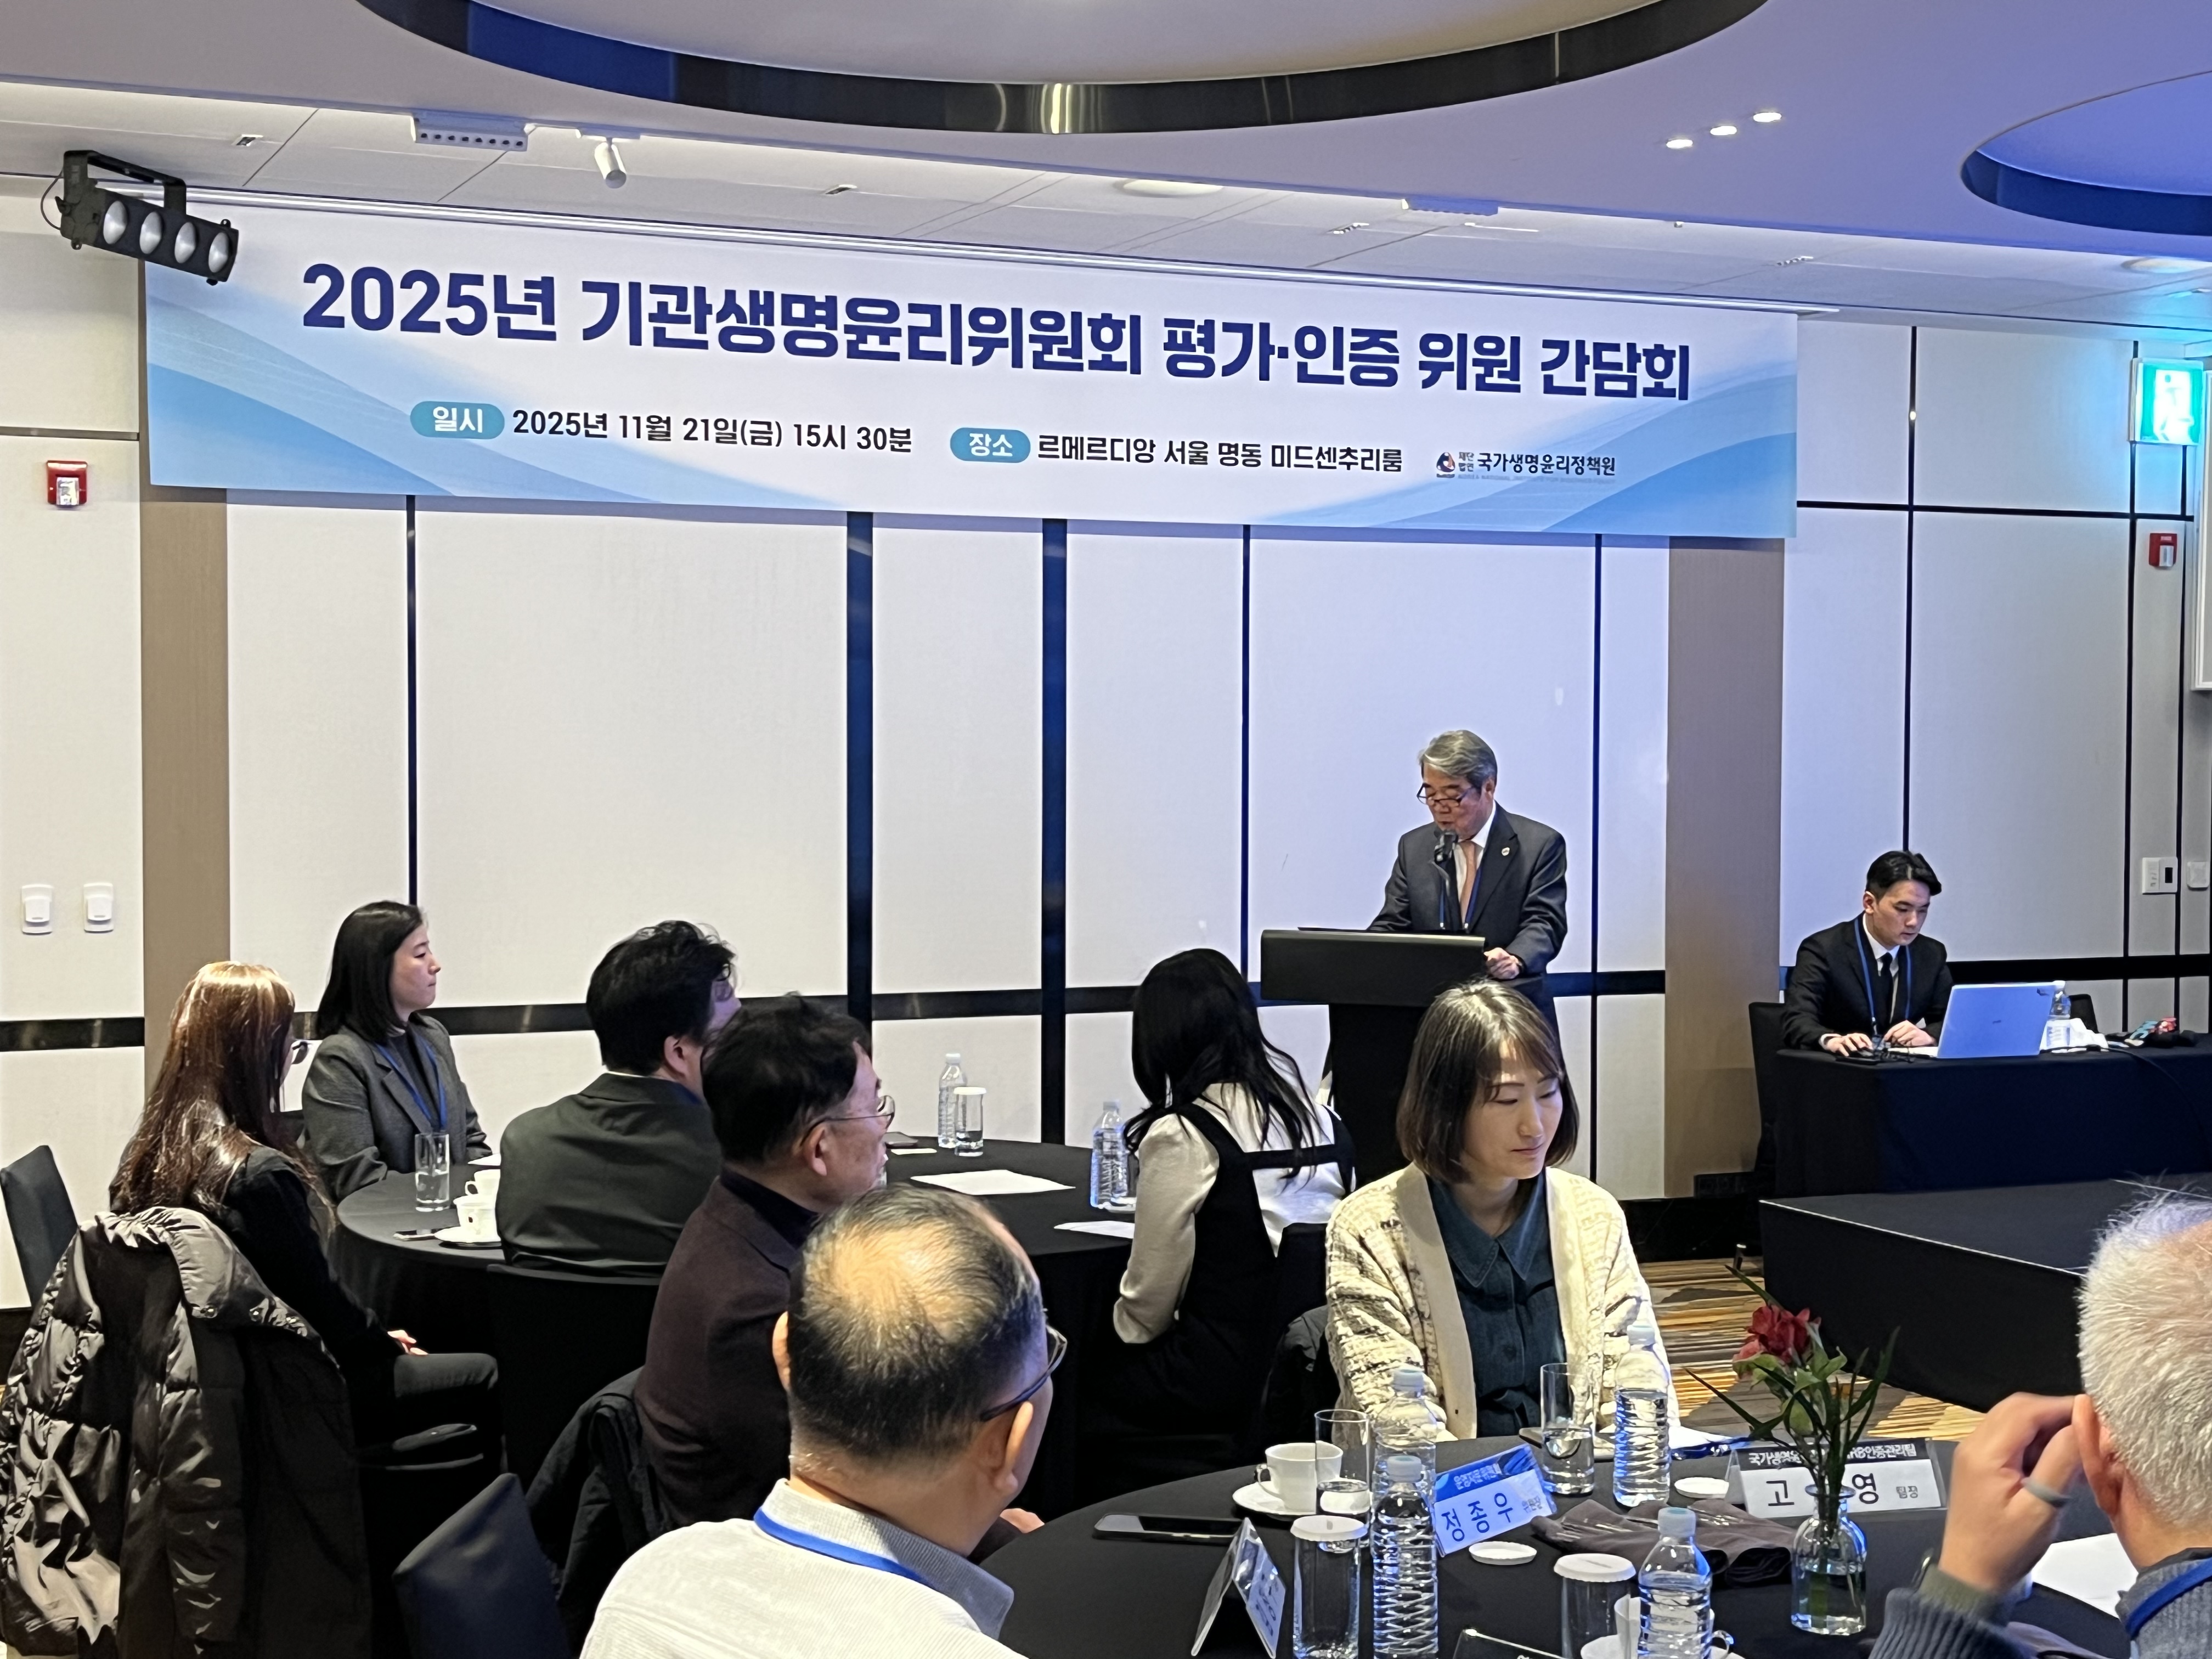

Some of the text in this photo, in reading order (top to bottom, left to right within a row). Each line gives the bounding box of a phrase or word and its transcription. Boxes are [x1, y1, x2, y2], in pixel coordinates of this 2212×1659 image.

[303, 263, 1690, 402] 2025년 기관생명윤리위원회 평가·인증 위원 간담회
[433, 407, 912, 454] 일시 2025년 11월 21일(금) 15시 30분
[968, 432, 1403, 473] 장소 르메르디앙 서울 명동 미드센추리룸
[1477, 453, 1616, 477] 국가생명윤리정책원
[1441, 1492, 1514, 1542] 정종우
